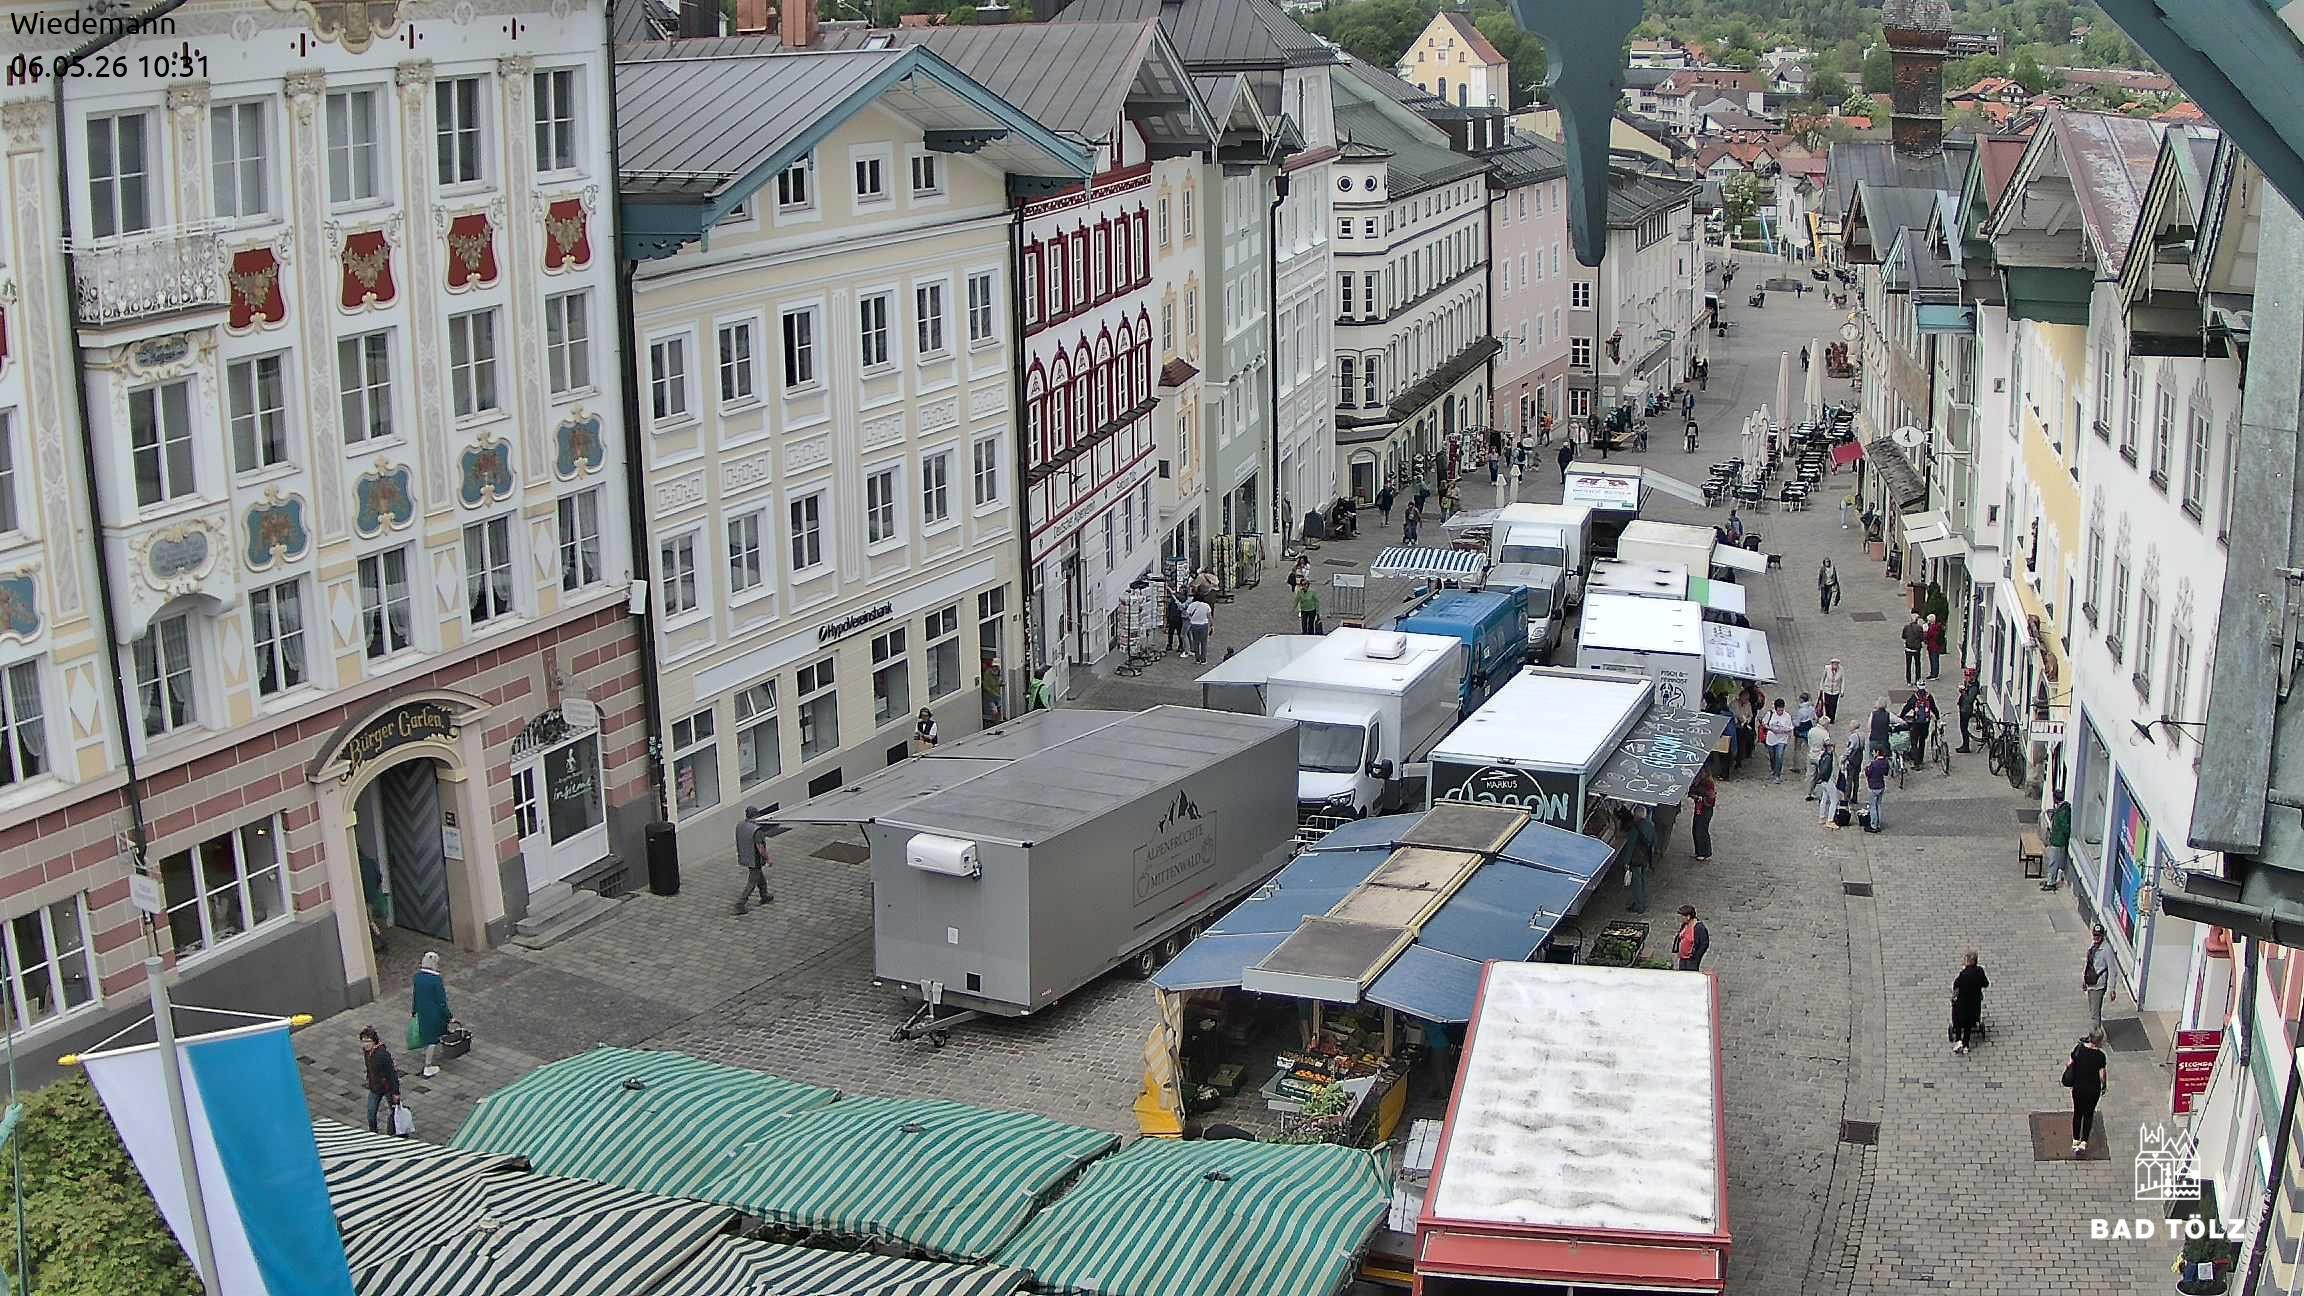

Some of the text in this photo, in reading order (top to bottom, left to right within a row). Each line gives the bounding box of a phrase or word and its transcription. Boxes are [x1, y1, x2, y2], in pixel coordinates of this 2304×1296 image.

[827, 601, 893, 639] HypoVereinsbank
[350, 721, 394, 765] Bürger
[1486, 780, 1518, 789] MARKUS
[1147, 824, 1203, 860] ALPENFRÜCHTE
[1150, 852, 1202, 889] MITTENWALD
